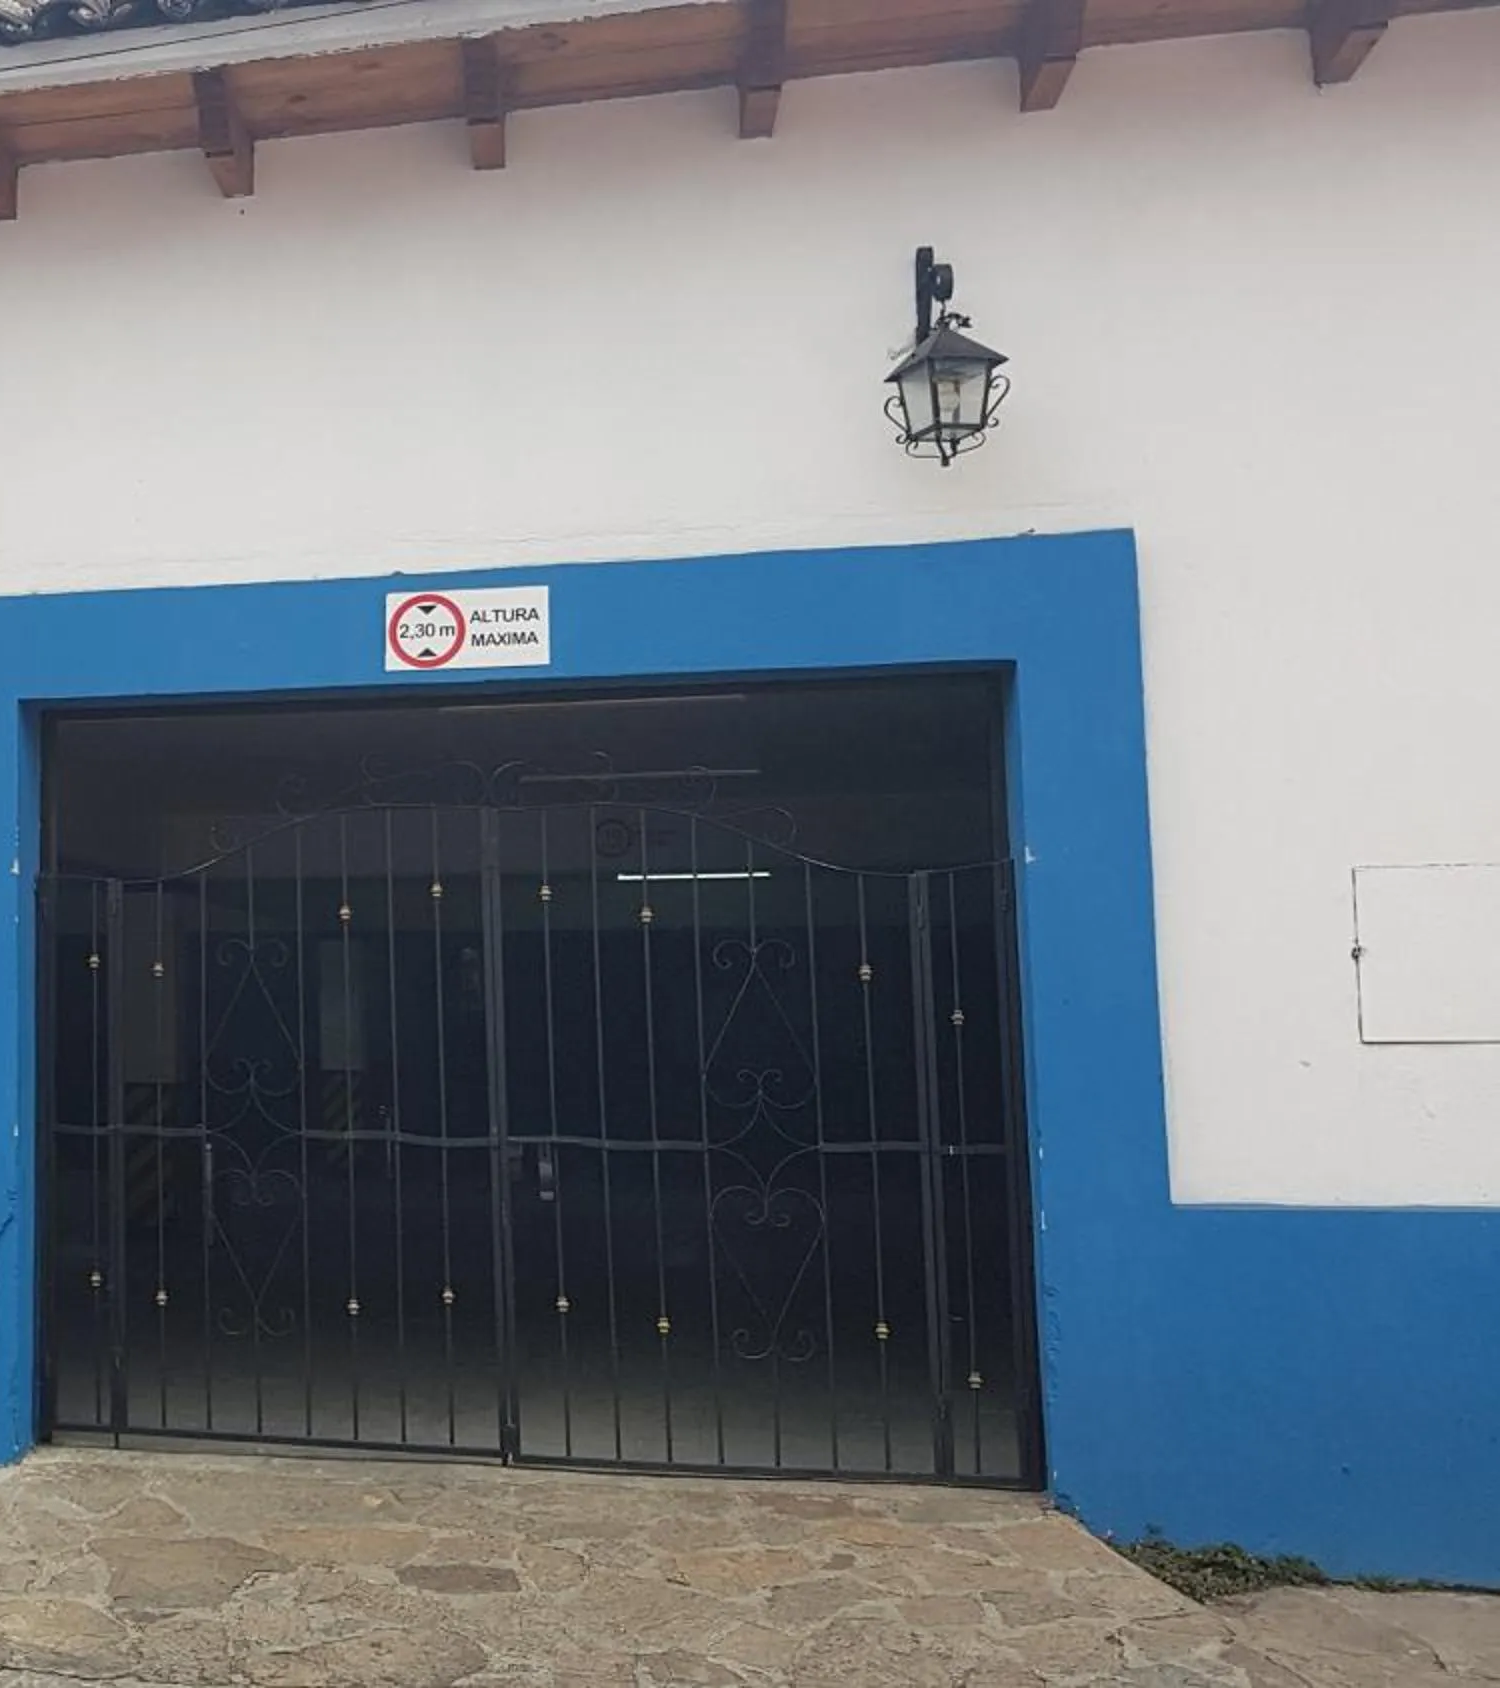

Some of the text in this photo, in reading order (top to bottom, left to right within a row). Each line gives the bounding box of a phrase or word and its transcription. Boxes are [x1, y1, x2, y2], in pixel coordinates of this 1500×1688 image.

[470, 607, 540, 624] ALTURA
[399, 623, 455, 640] 2,30 m
[471, 631, 539, 647] MAXIMA
